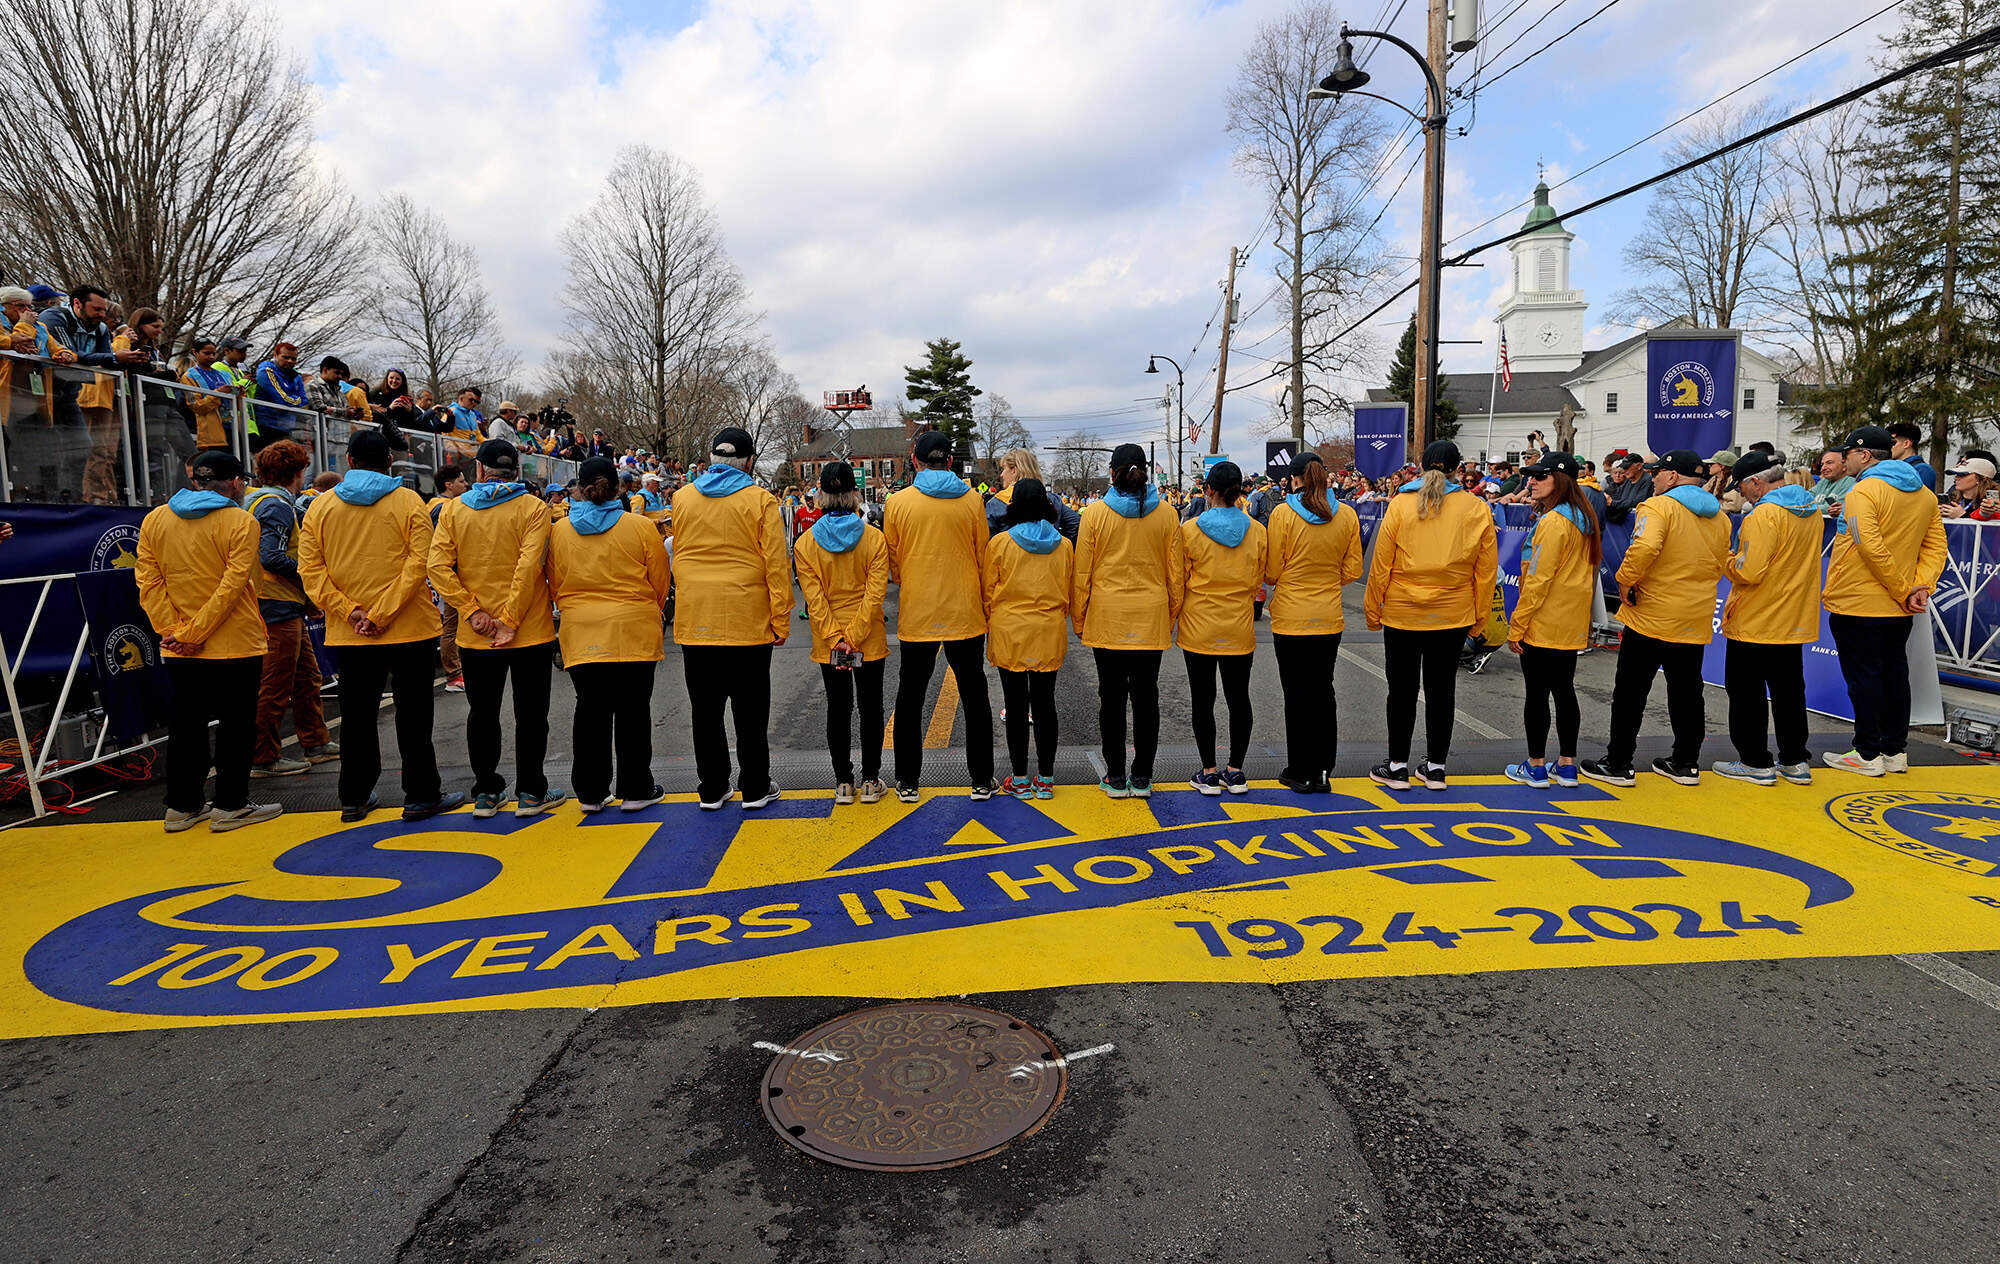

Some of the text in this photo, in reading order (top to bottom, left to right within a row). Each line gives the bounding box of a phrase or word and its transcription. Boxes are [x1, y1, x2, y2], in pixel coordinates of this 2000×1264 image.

[1664, 364, 1691, 383] BOSTON
[1693, 365, 1713, 402] MARATHON
[96, 527, 129, 558] BOSTON
[107, 627, 129, 650] BOSTON
[1810, 645, 1831, 655] BANK
[106, 653, 115, 669] THE
[1842, 793, 1920, 826] BOSTON
[106, 820, 1625, 991] 100 YEARS IN HOPKINTON
